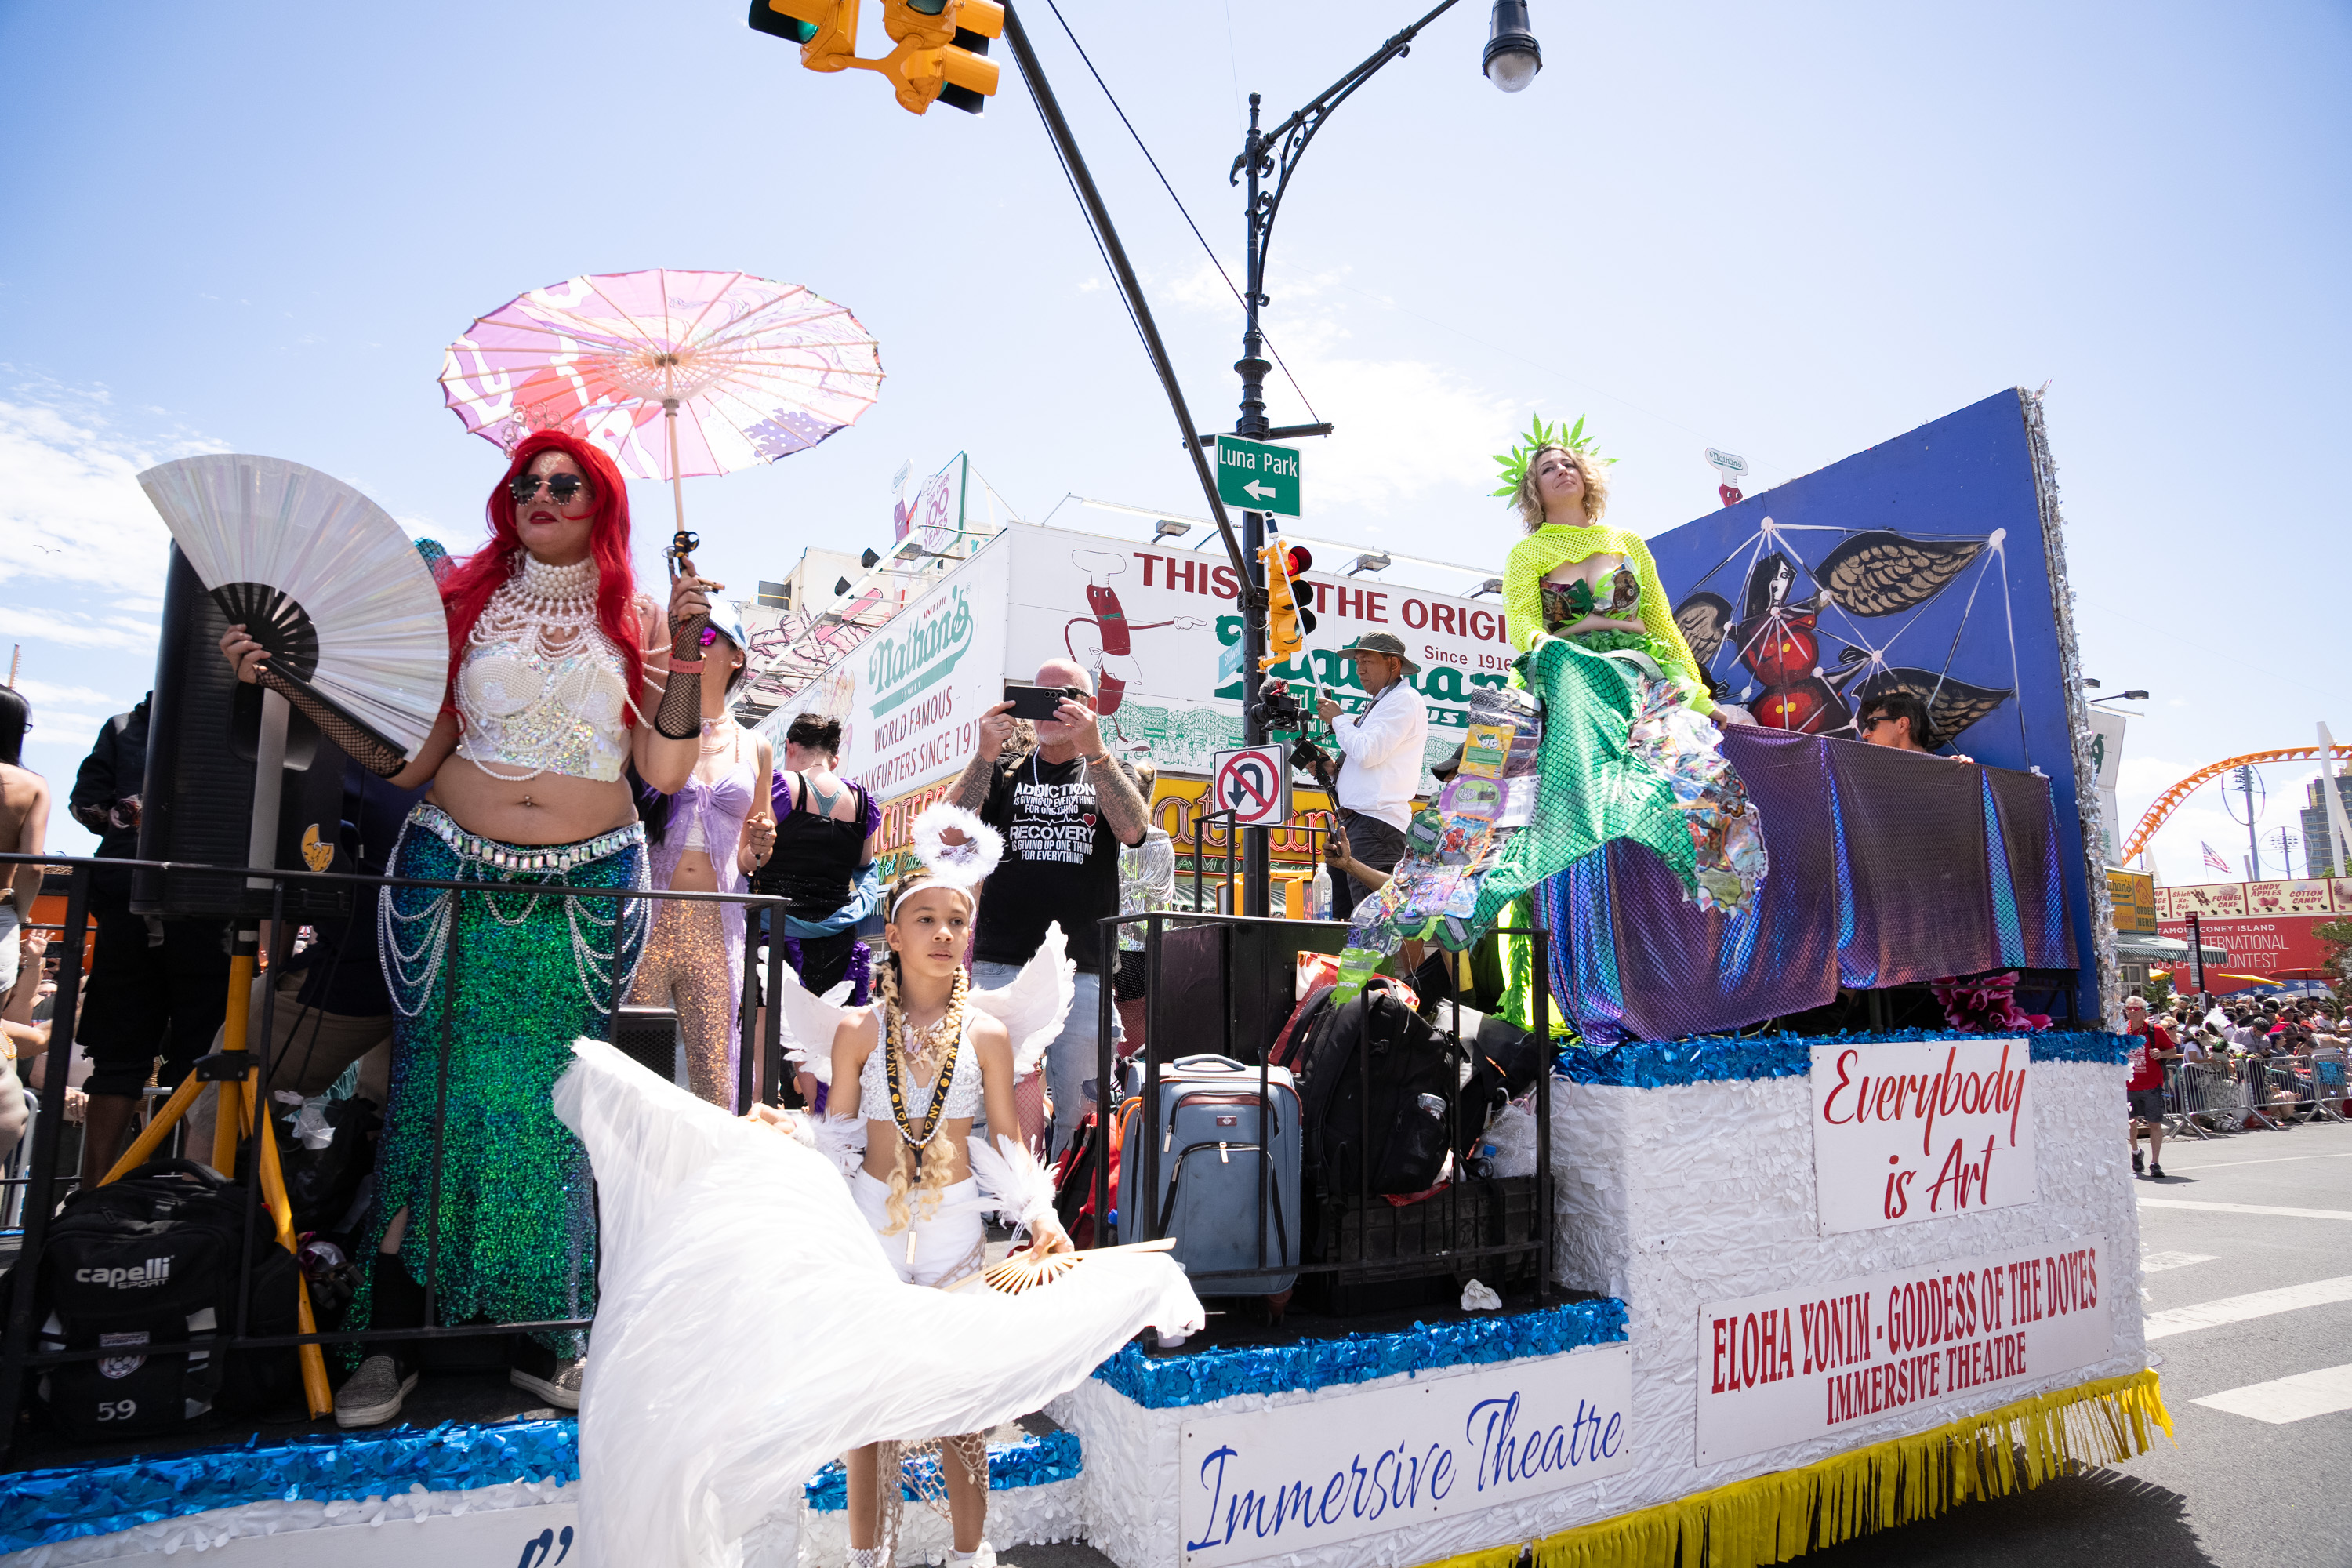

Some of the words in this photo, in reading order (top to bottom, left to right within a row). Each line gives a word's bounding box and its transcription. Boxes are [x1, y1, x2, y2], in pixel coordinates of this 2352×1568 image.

[1219, 445, 1256, 470] Luna
[1264, 452, 1298, 477] Park
[936, 474, 950, 495] OVER
[925, 487, 949, 535] 100
[924, 512, 949, 550] YEARS
[1133, 551, 1240, 600] THIS
[1307, 580, 1388, 624] THE
[1401, 598, 1512, 644] ORIGI
[869, 584, 971, 695] Nathan's
[1424, 644, 1468, 665] Since
[1477, 653, 1513, 672] 1916
[873, 714, 906, 753] WORLD
[909, 685, 953, 735] FAMOUS
[852, 753, 916, 793] RANKFURTERS
[919, 732, 951, 773] SINCE
[956, 718, 978, 757] 191
[1013, 797, 1020, 805] IS
[1020, 796, 1043, 805] GIVING
[1044, 798, 1053, 808] UP
[1054, 795, 1095, 808] EVERYTHING
[1014, 782, 1097, 798] ADDICTION
[1025, 804, 1040, 814] FOR
[1040, 806, 1055, 816] ONE
[1057, 804, 1079, 815] THING
[1009, 826, 1096, 844] RECOVERY
[1011, 841, 1018, 852] IS
[1018, 839, 1043, 851] GIVING
[1044, 840, 1054, 850] UP
[1055, 840, 1071, 851] ONE
[1072, 841, 1094, 855] THING
[1021, 850, 1036, 860] FOR
[1036, 850, 1084, 865] EVERYTHING
[2136, 906, 2154, 916] ORDER
[2137, 917, 2155, 927] HERE!
[2201, 934, 2289, 950] TERNATIONAL
[2237, 924, 2276, 932] ISLAND
[1824, 1044, 2027, 1156] Everybody
[1884, 1154, 1918, 1220] is
[1926, 1134, 2004, 1213] Art
[75, 1257, 171, 1289] capelli
[118, 1277, 169, 1290] SPORT
[1711, 1307, 1794, 1395] ELOHA
[1800, 1291, 1871, 1375] YONIM
[1876, 1324, 1883, 1340] -
[1888, 1270, 1976, 1356] GODDESS
[1981, 1265, 2005, 1334] OF
[2009, 1258, 2042, 1327] THE
[2045, 1247, 2098, 1319] DOVES
[1826, 1352, 1940, 1426] IMMERSIVE
[1945, 1330, 2027, 1392] THEATRE
[96, 1399, 137, 1422] 59
[1186, 1440, 1457, 1552] Immersive
[1465, 1390, 1624, 1493] Theatre
